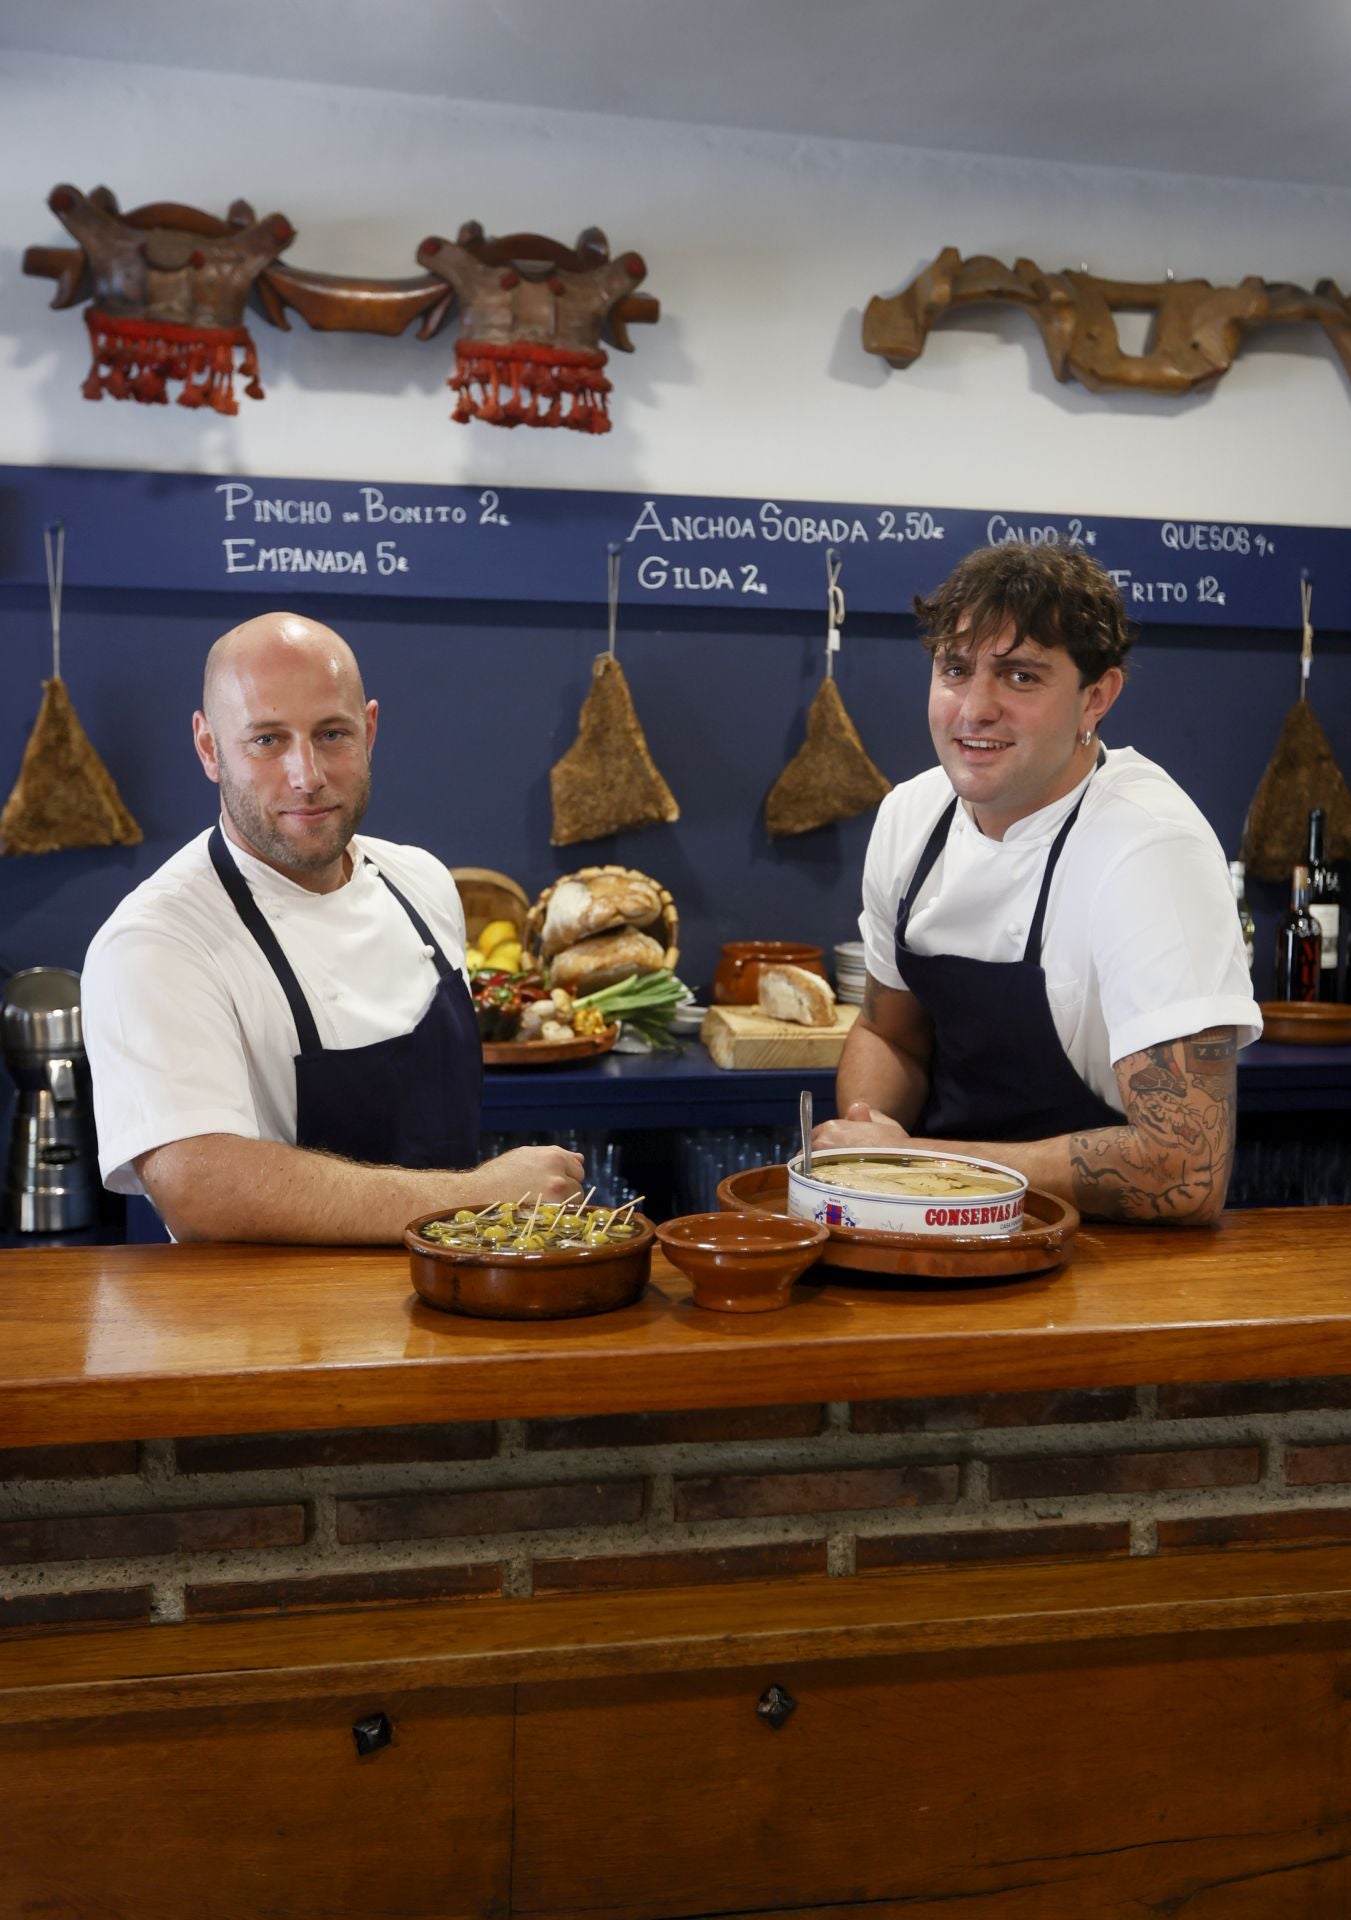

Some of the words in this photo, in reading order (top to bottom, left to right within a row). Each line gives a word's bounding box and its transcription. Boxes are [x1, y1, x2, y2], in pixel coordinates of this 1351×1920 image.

[215, 482, 332, 524] PINCHO
[359, 487, 467, 524] BONITO
[626, 501, 756, 542] ANCHOA
[759, 502, 869, 543] SOBADA
[1161, 522, 1251, 555] QUESOS
[222, 538, 368, 575] EMPANADA
[637, 556, 735, 590] GILDA
[1107, 569, 1187, 603] FRITO
[925, 1203, 1011, 1226] CONSERVAS
